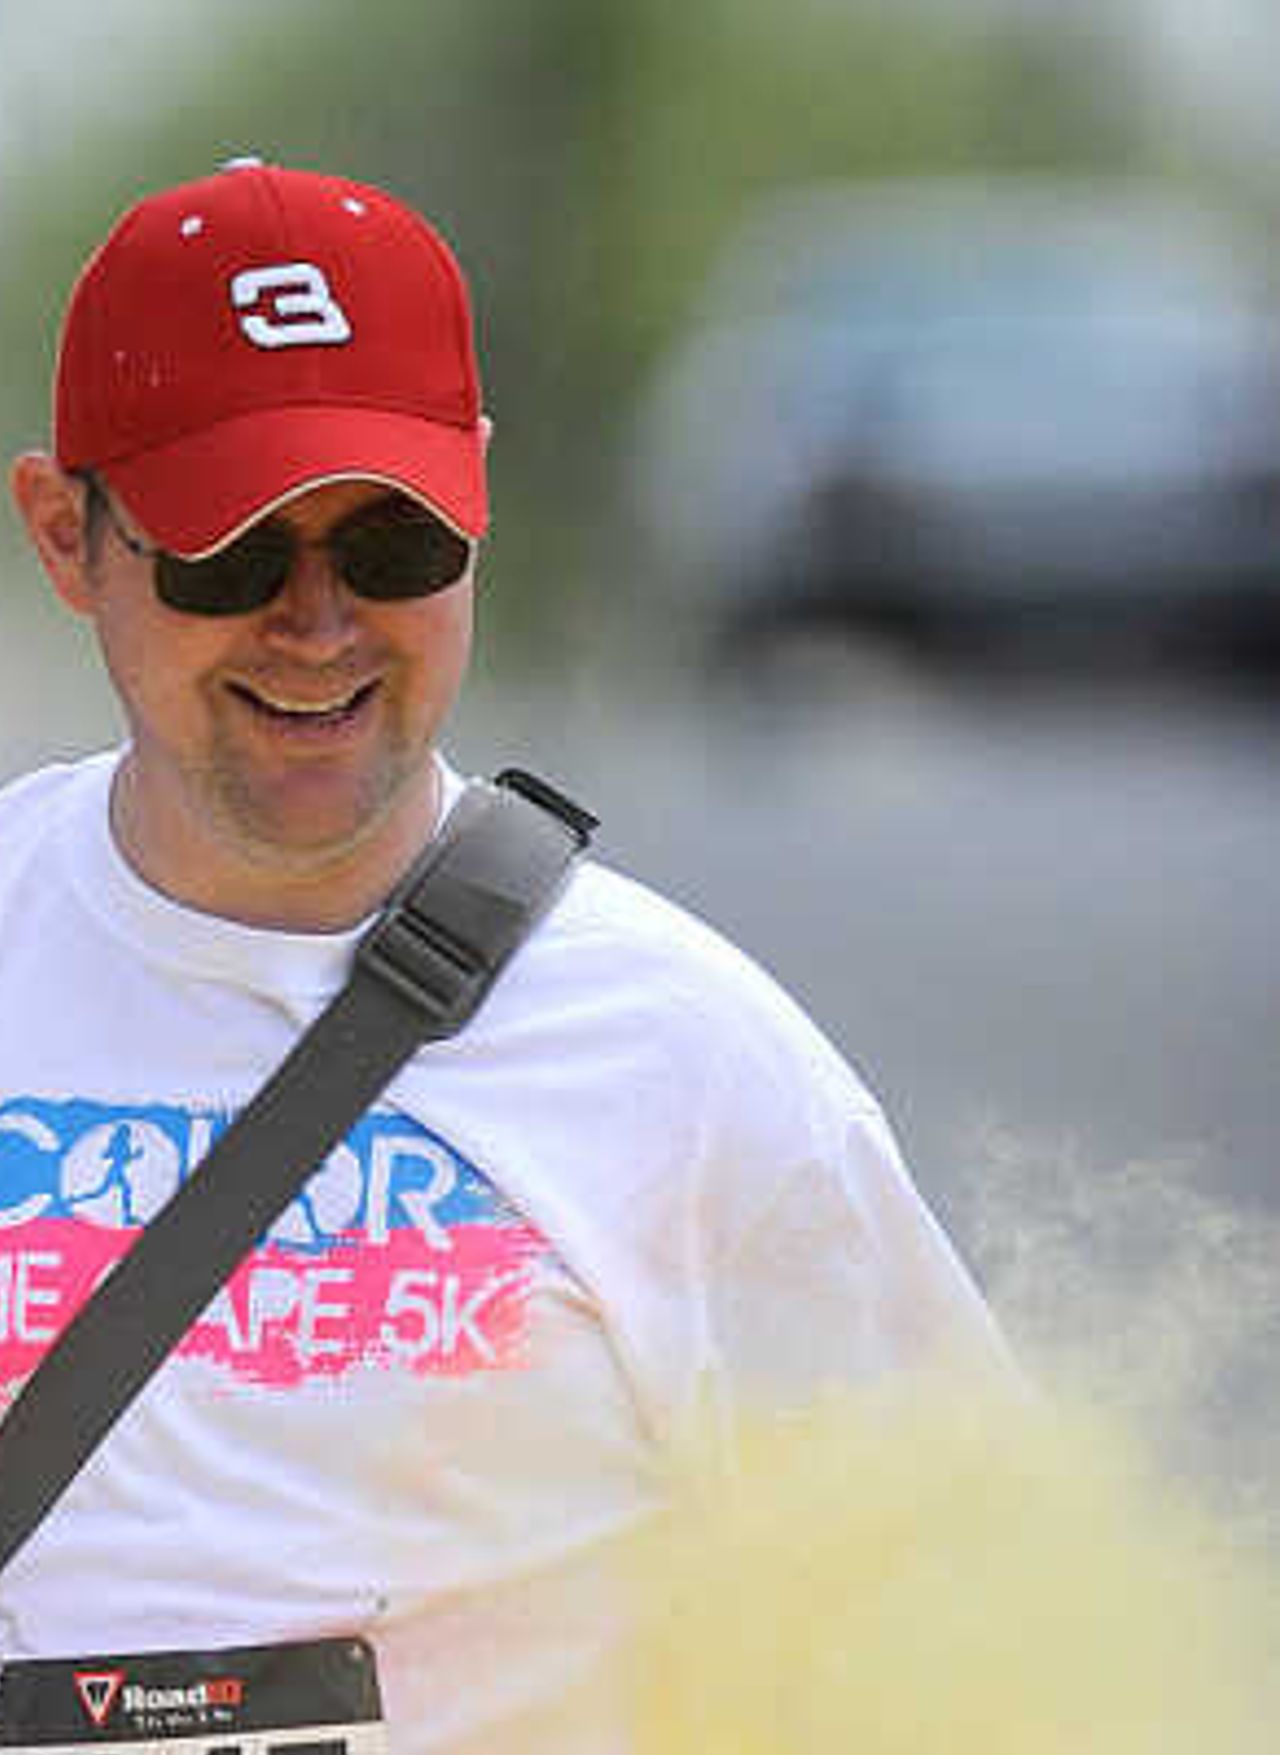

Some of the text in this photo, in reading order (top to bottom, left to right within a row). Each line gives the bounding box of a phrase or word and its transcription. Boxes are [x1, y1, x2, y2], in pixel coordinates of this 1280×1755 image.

[230, 261, 353, 348] 3
[90, 1258, 354, 1356] APE
[383, 1271, 508, 1362] 5K
